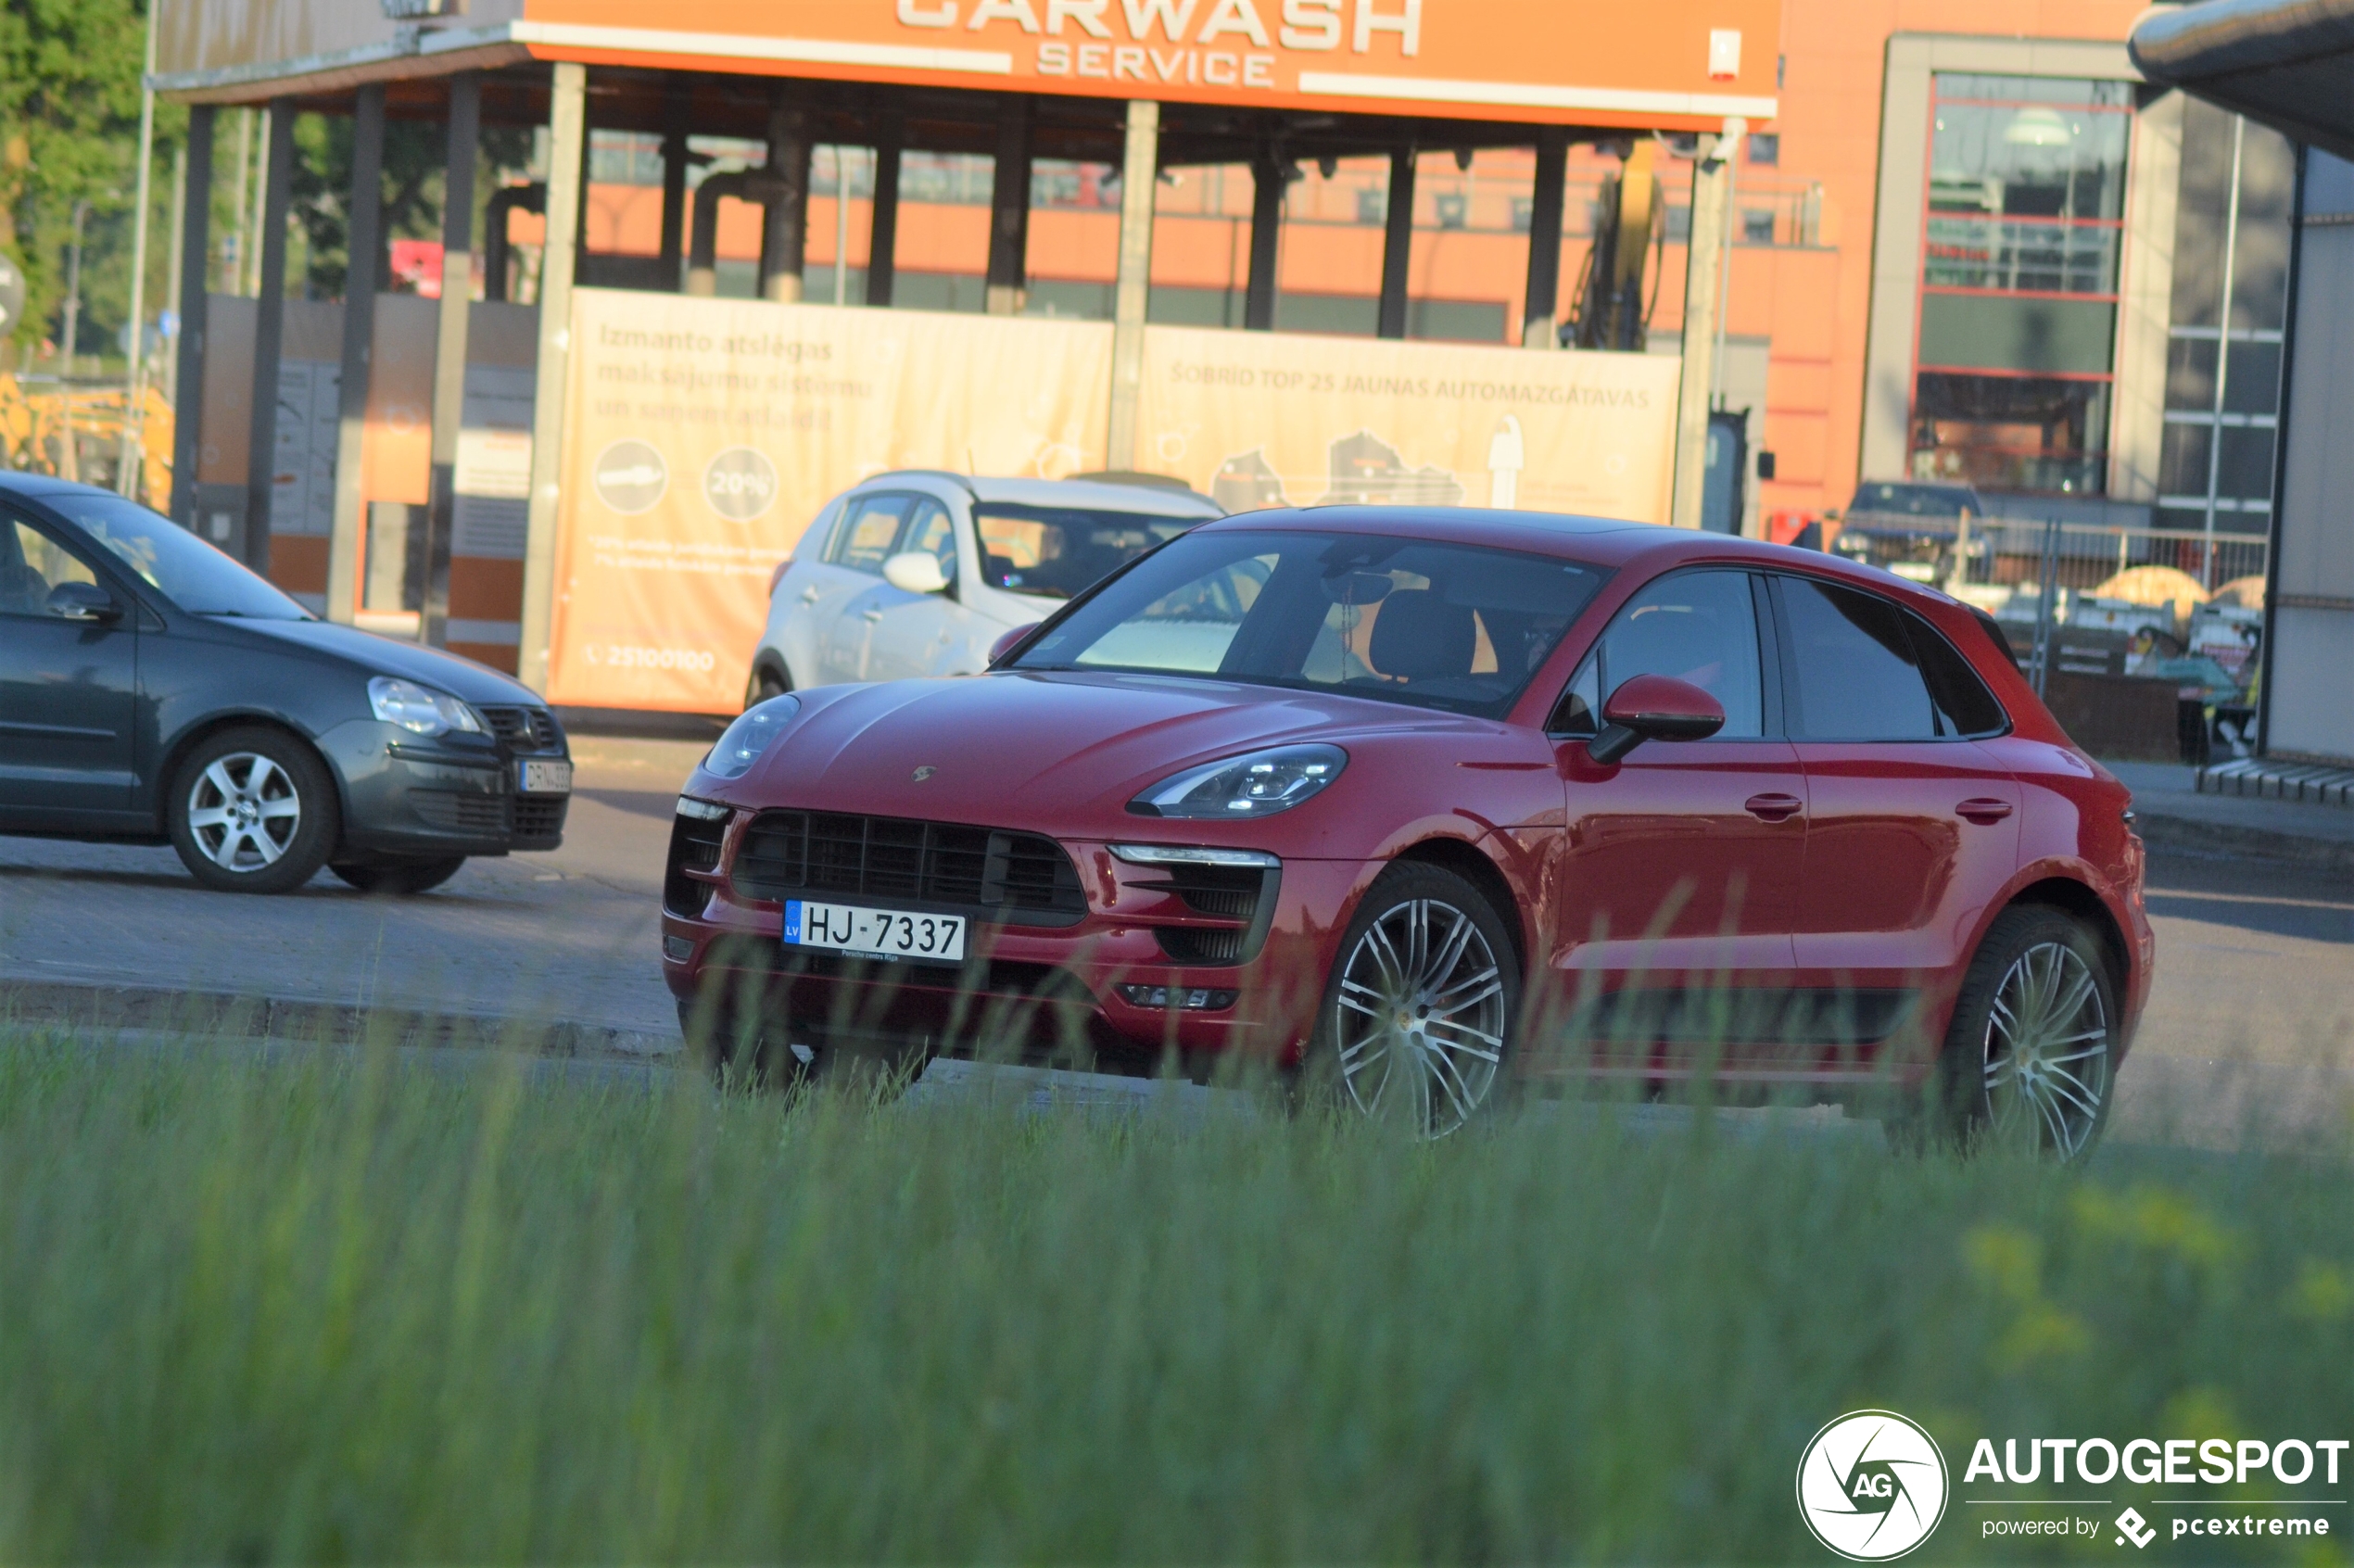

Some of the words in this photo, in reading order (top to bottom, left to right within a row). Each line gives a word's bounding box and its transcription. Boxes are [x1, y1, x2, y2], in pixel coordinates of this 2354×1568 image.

[1037, 43, 1274, 87] SERVICE
[599, 322, 714, 352] Izmanto
[1260, 370, 1303, 390] TOP
[1309, 375, 1335, 392] 25
[1340, 376, 1429, 398] JAUNAS
[711, 471, 771, 496] 20%
[607, 645, 715, 672] 25100100
[786, 926, 799, 937] LV
[808, 906, 958, 955] HJ-7337
[842, 949, 865, 959] Porsche
